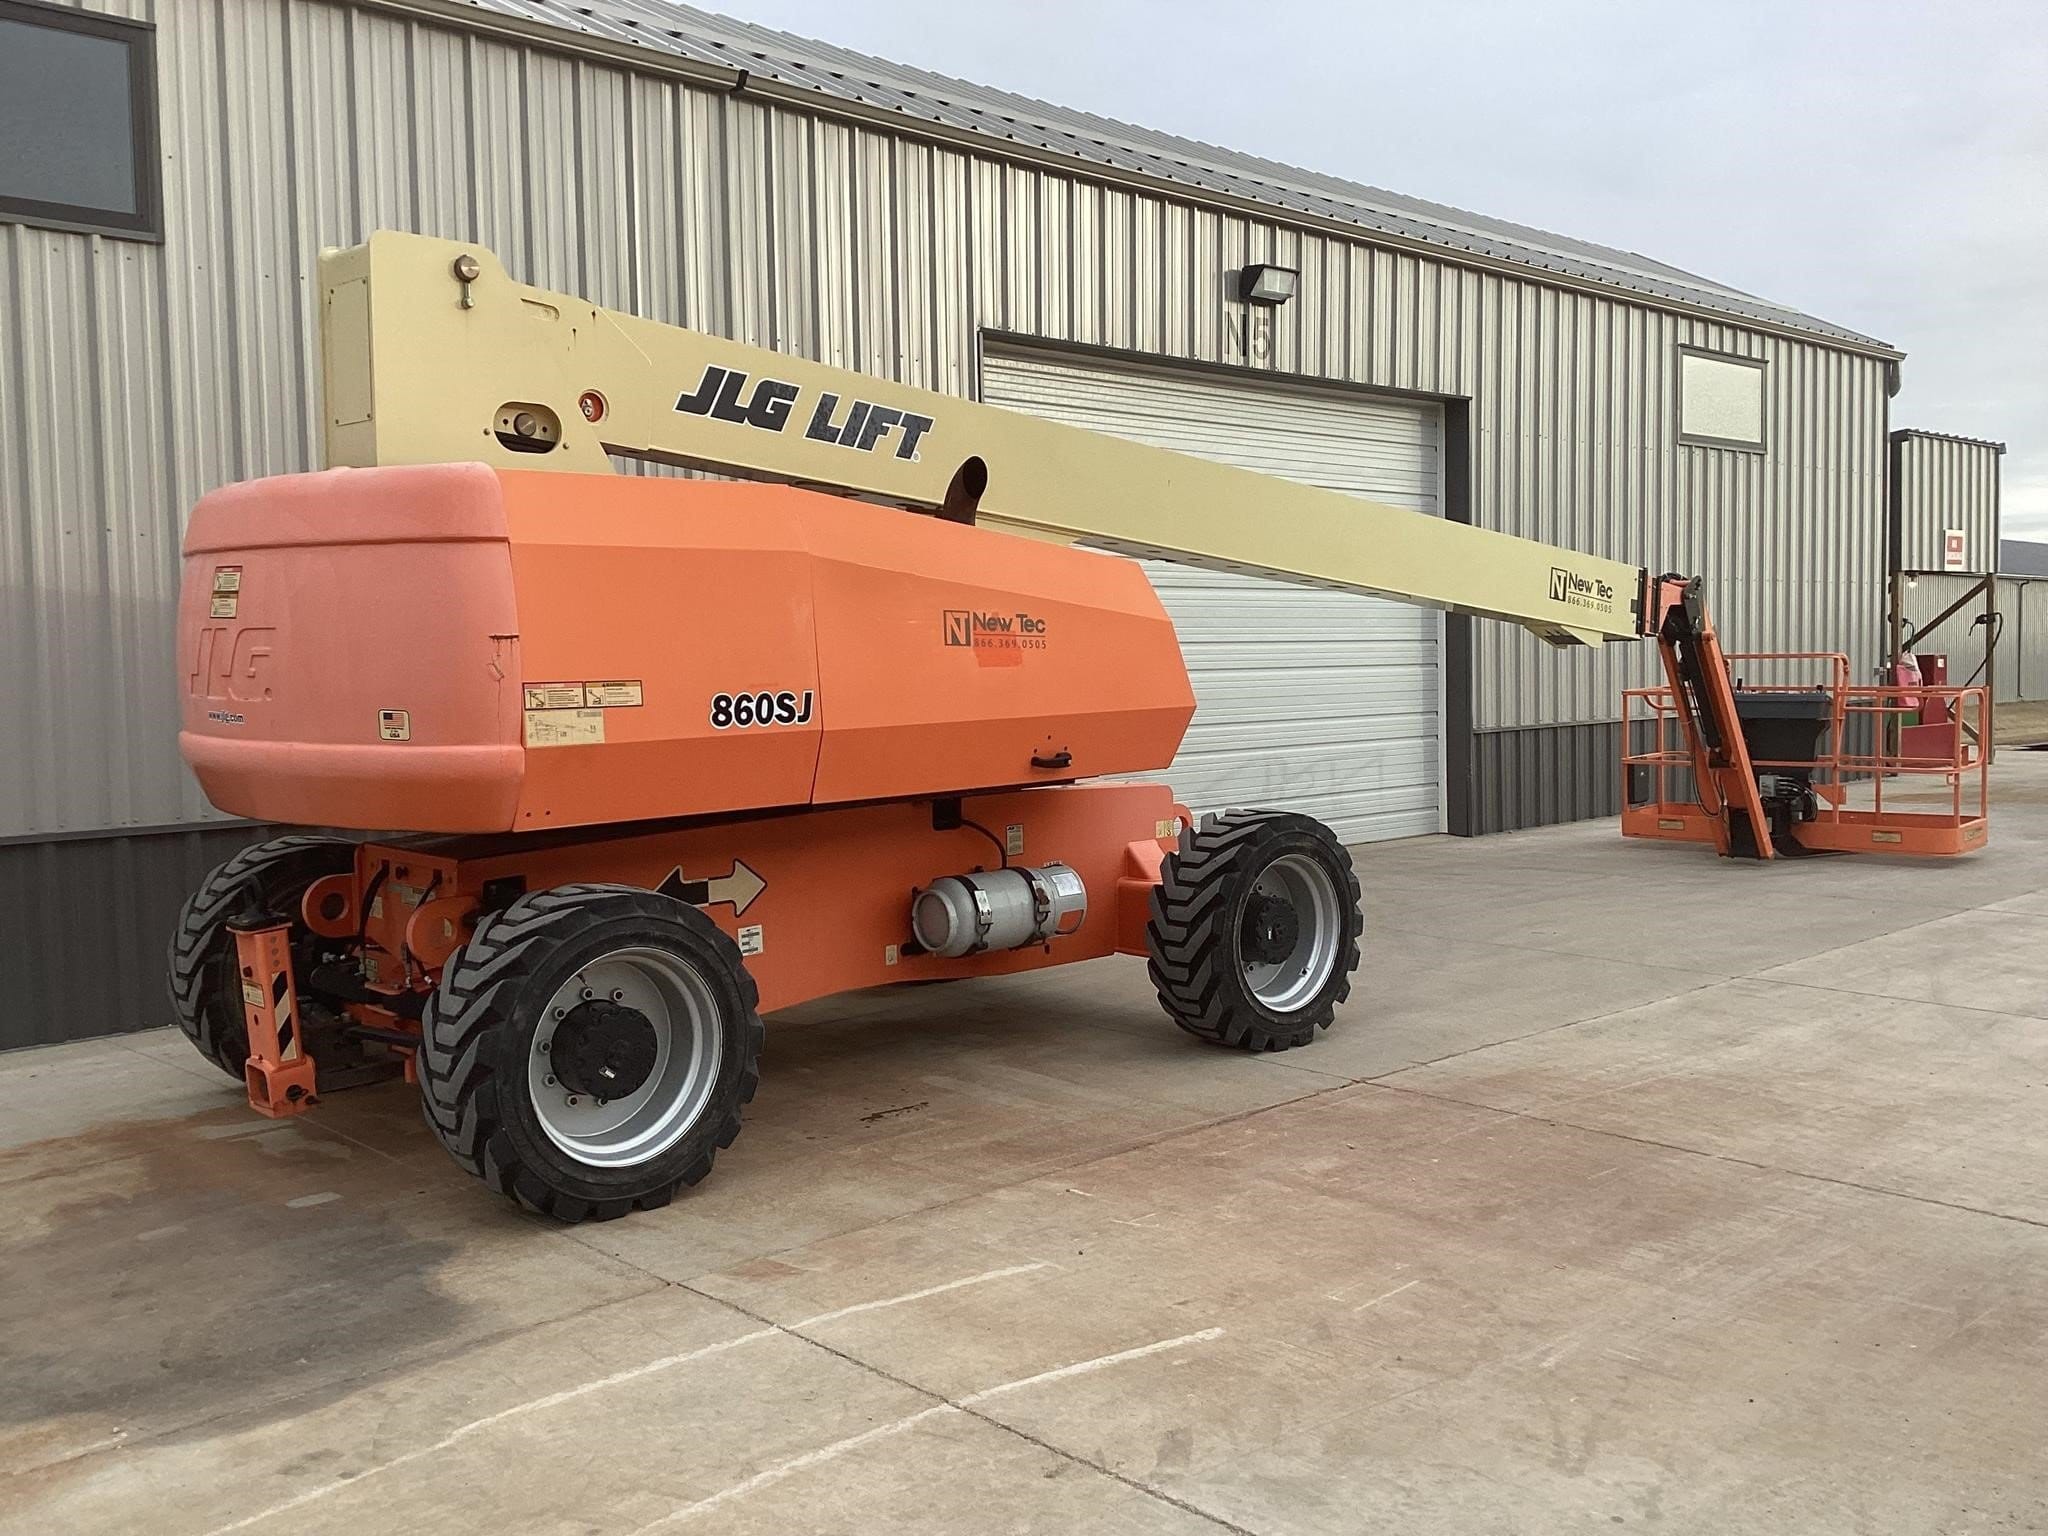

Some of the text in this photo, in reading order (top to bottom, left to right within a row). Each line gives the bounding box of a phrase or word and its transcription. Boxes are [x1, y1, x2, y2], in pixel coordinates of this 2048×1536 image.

[672, 363, 936, 461] JLG LIFT
[1568, 572, 1613, 599] New Tec
[972, 611, 1046, 634] New Tec
[710, 690, 814, 729] 860SJ
